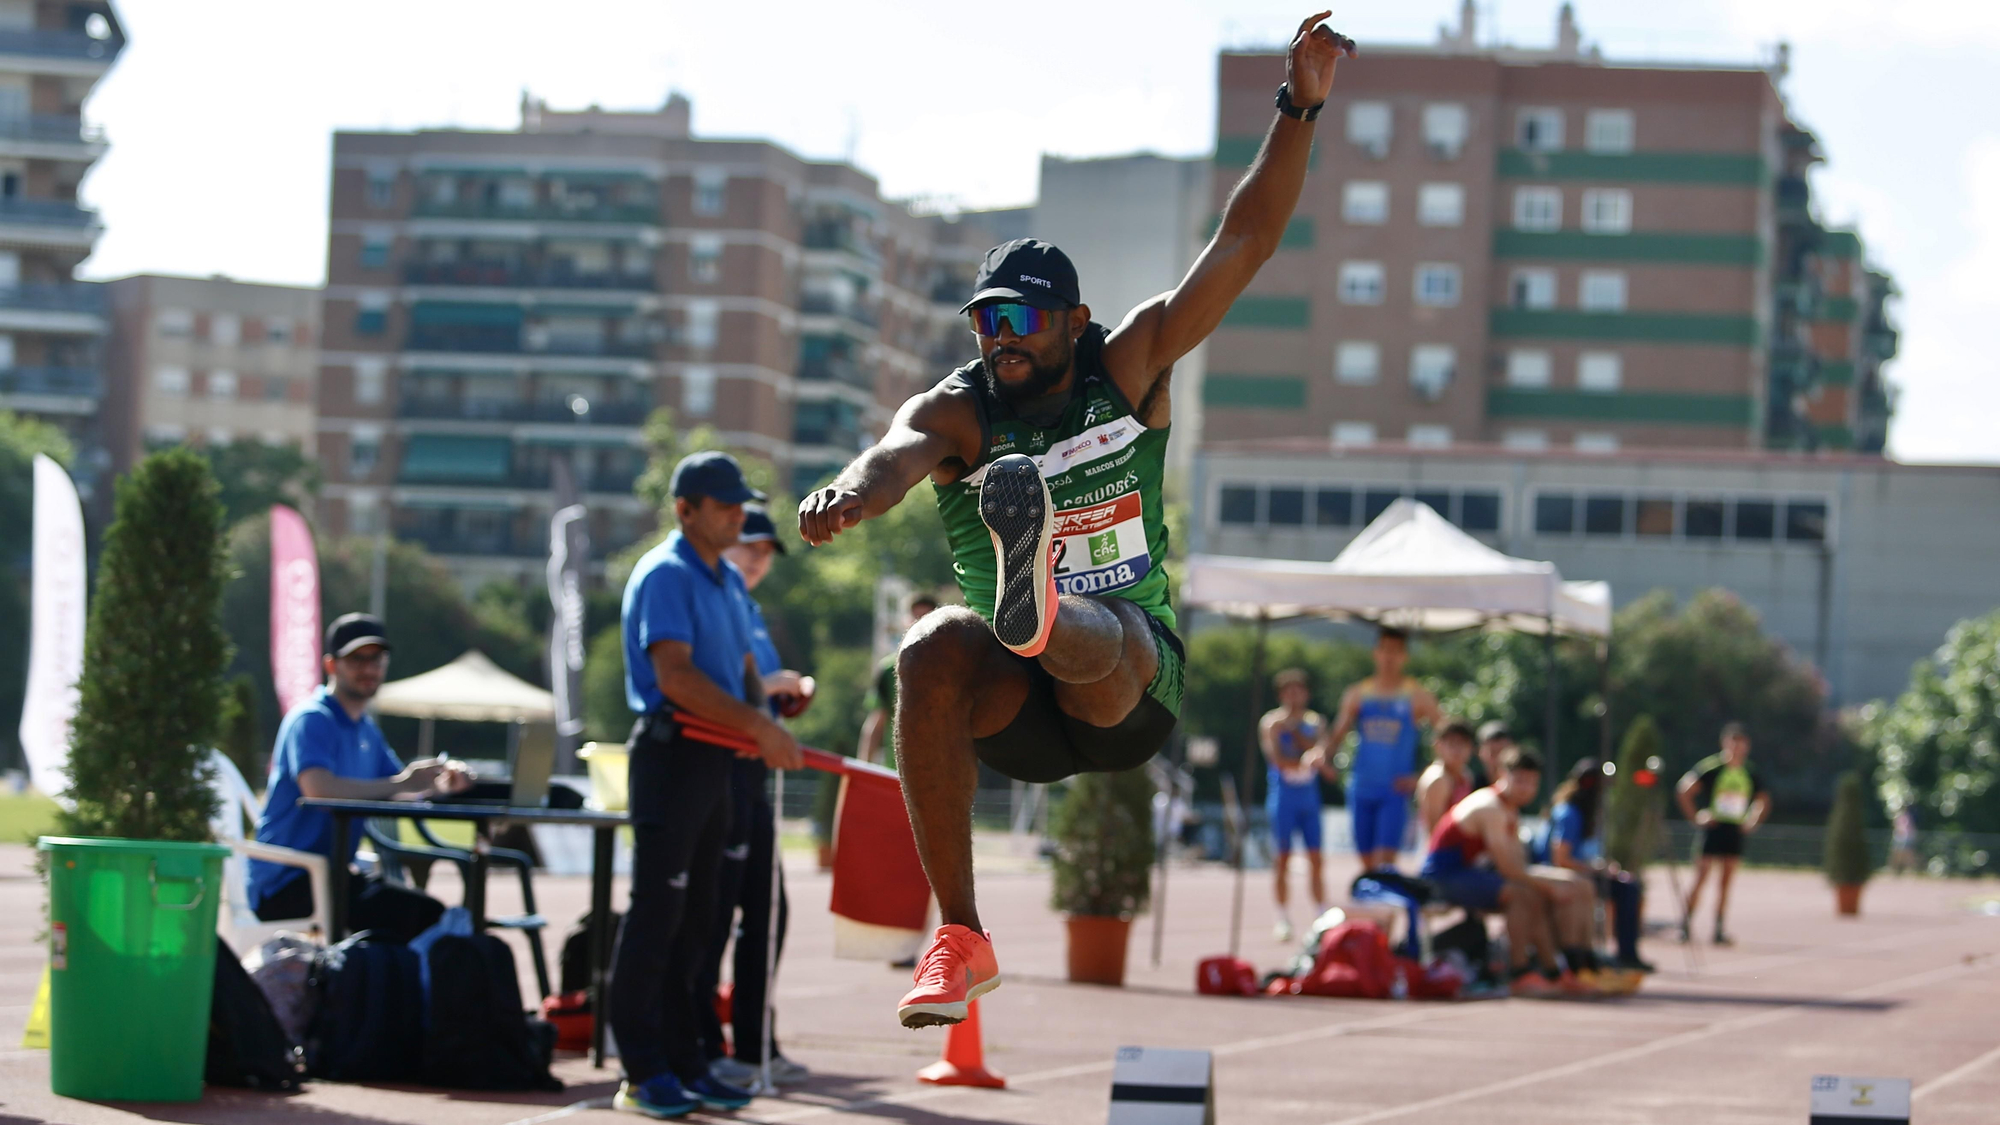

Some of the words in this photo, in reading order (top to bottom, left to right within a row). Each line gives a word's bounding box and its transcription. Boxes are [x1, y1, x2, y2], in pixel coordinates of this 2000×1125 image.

[1019, 274, 1052, 288] SPORTS
[1084, 460, 1115, 477] MARCOS
[1065, 504, 1117, 526] RFEA
[1093, 543, 1117, 558] CAC
